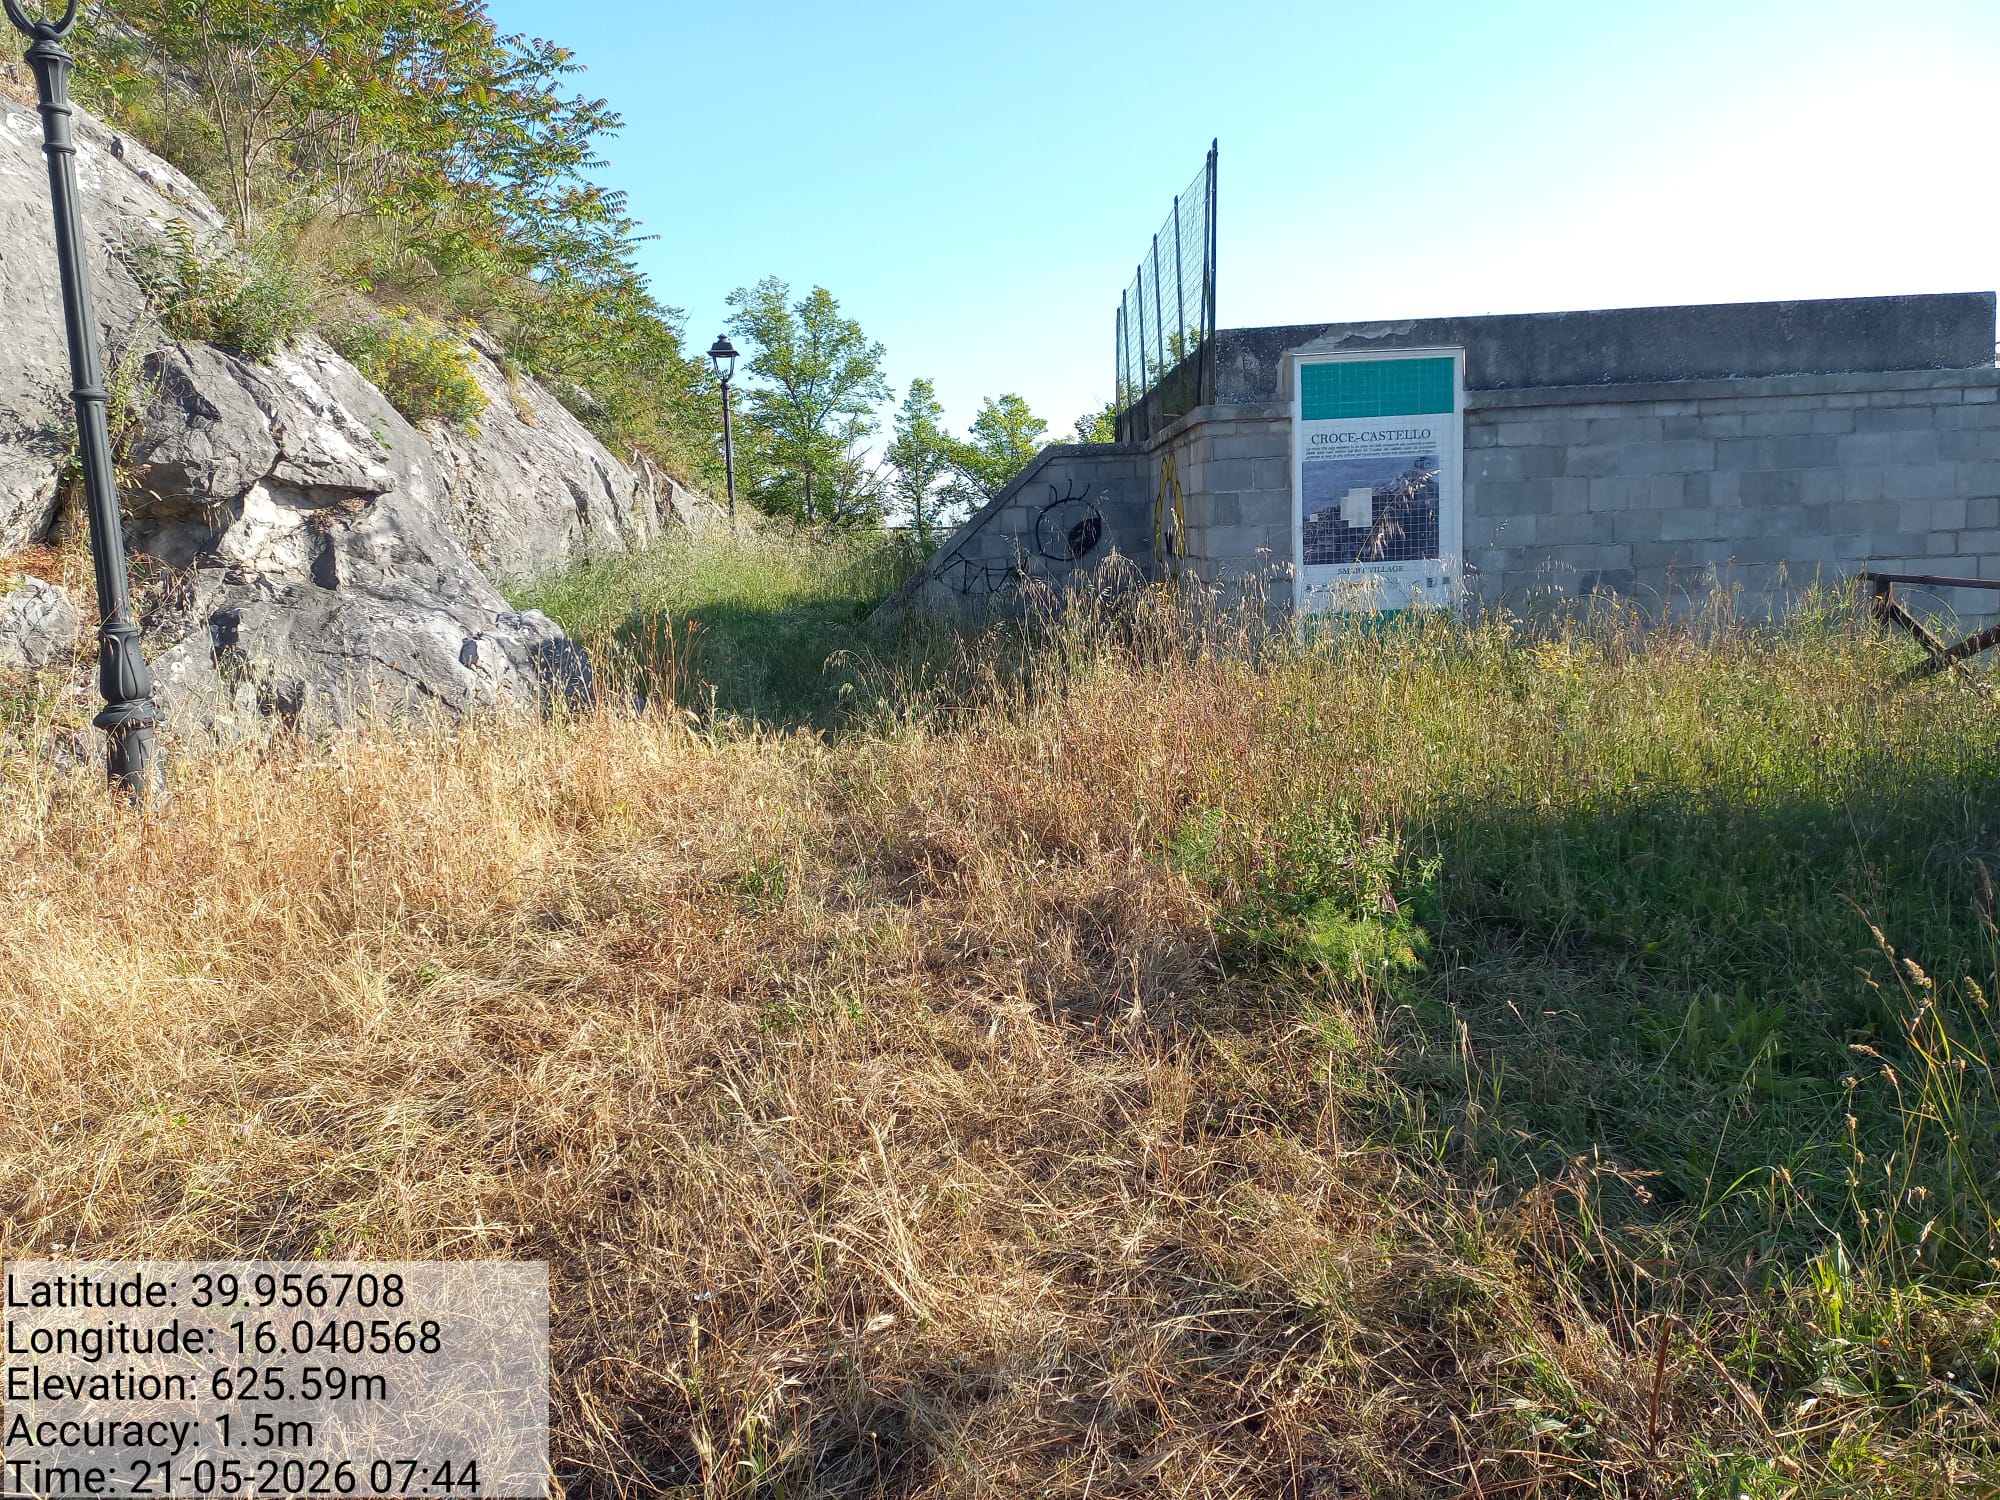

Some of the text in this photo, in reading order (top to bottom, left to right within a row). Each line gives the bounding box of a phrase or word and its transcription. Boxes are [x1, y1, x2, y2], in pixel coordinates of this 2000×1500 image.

[1311, 428, 1431, 445] CROCE-CASTELLO
[1337, 565, 1404, 575] SMRT VILLAGE
